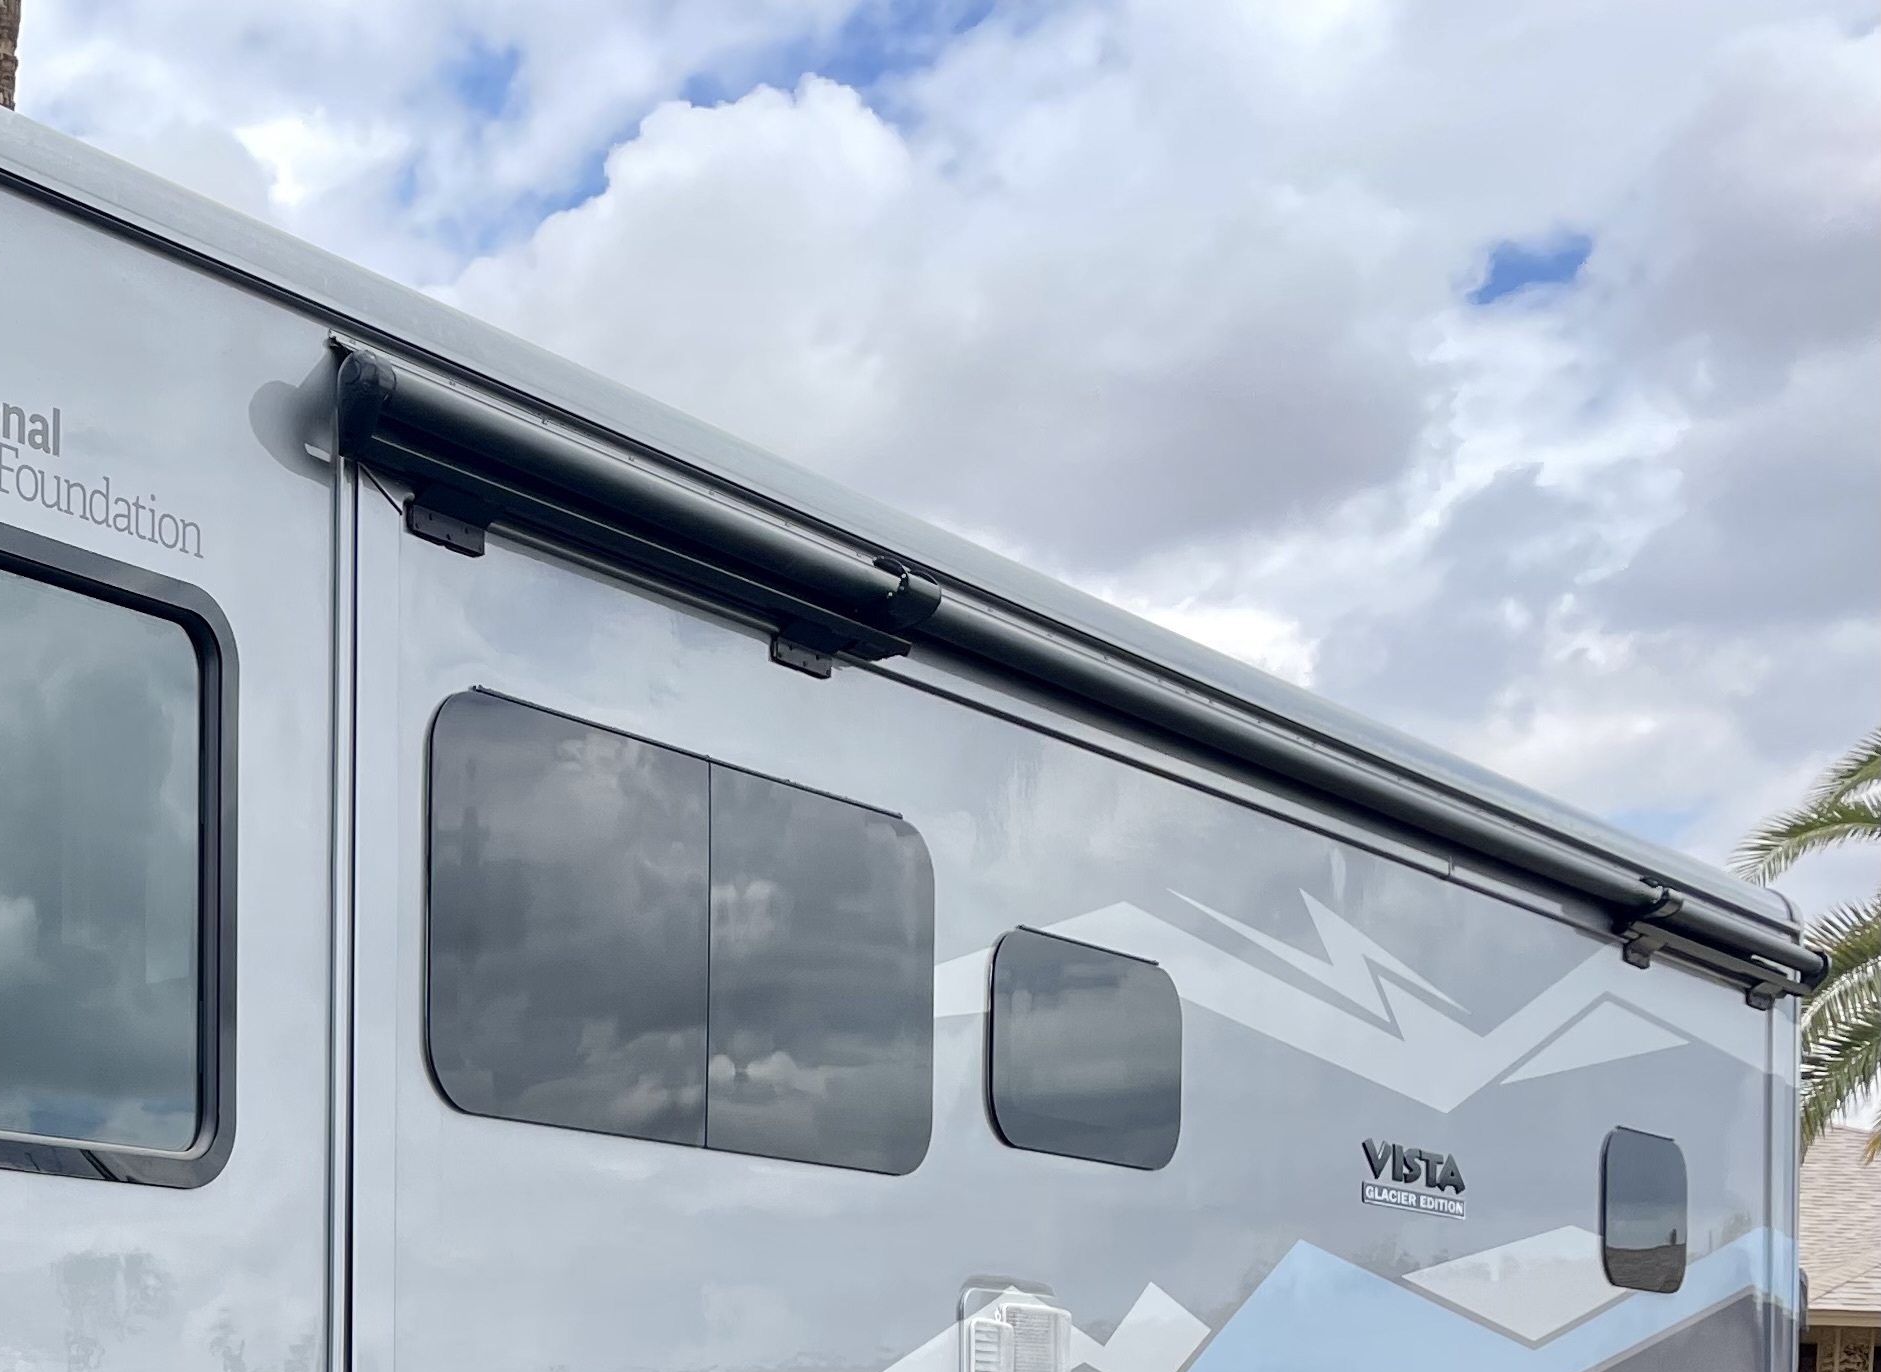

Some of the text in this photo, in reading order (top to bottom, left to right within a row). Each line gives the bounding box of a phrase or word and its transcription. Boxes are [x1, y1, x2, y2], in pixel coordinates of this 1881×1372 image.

[1361, 1138, 1466, 1195] VISTA
[1365, 1185, 1464, 1214] GLACIER EDITION
